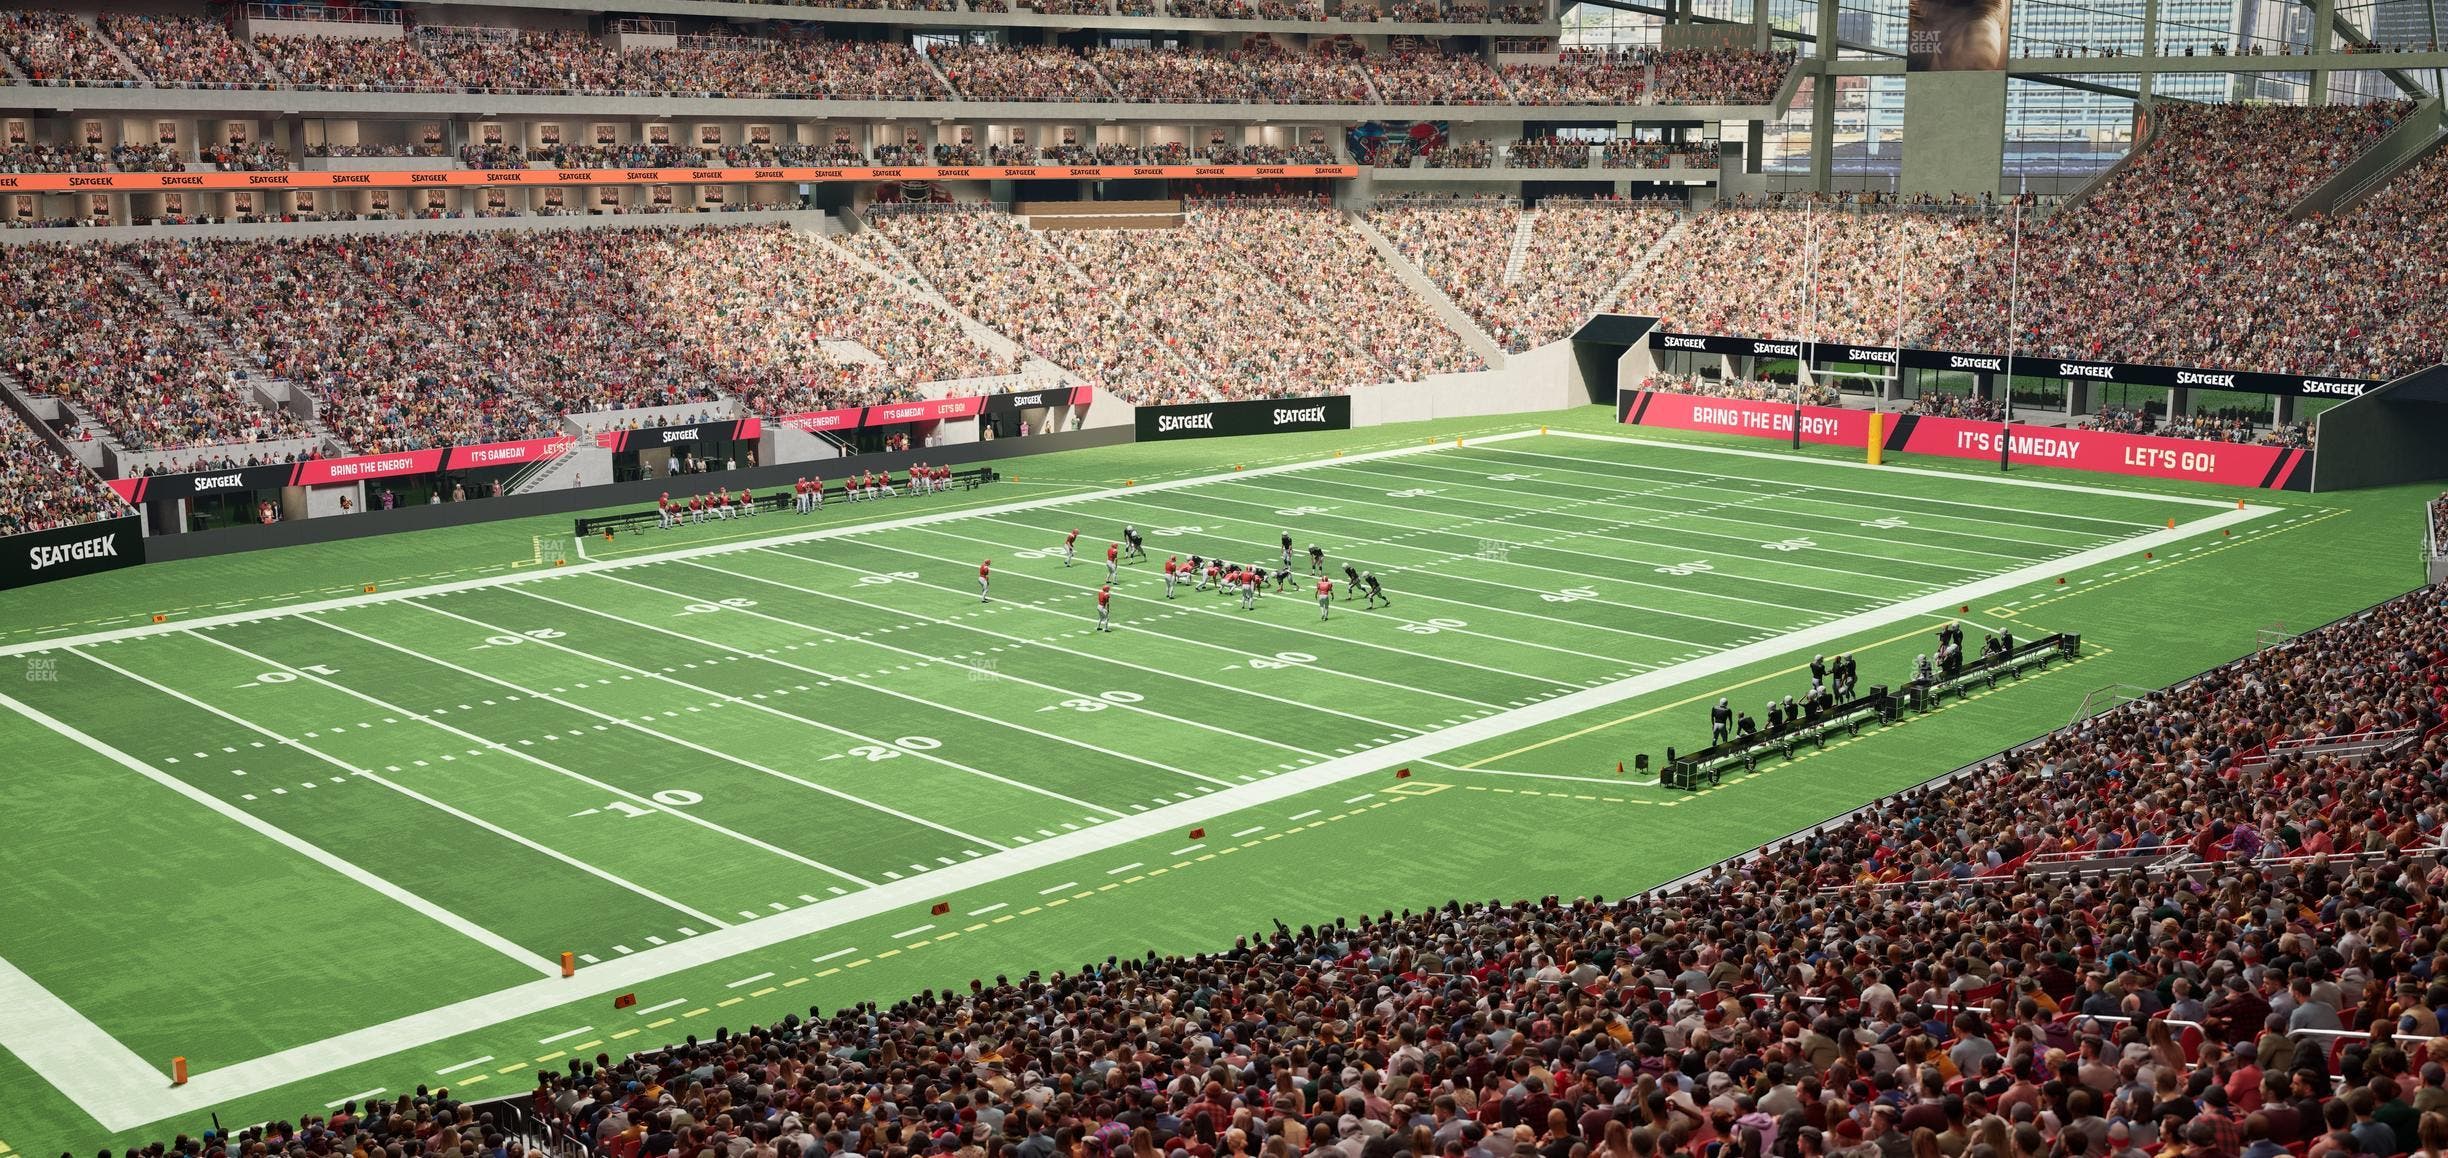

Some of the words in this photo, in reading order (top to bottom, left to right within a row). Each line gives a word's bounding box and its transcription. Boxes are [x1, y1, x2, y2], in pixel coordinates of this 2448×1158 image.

[69, 177, 113, 186] SEATGEEK
[161, 176, 204, 185] SEATGEEK
[249, 176, 289, 185] SEATGEEK
[335, 175, 371, 183] SEATGEEK
[412, 174, 447, 183] SEATGEEK
[487, 173, 521, 182] SEATGEEK
[559, 173, 591, 181] SEATGEEK
[754, 171, 783, 179] SEATGEEK
[1664, 336, 1706, 350] SEATGEEK
[1753, 342, 1798, 357] SEATGEEK
[1849, 349, 1896, 364] SEATGEEK
[1951, 355, 2001, 371] SEATGEEK
[2060, 363, 2114, 379] SEATGEEK
[2177, 371, 2235, 388] SEATGEEK
[2303, 379, 2366, 396] SEATGEEK
[1014, 394, 1042, 408] SEATGEEK
[896, 406, 924, 418] GAMEDAY
[938, 404, 954, 413] LET'S
[1159, 412, 1213, 432] SEATGEEK
[1274, 405, 1326, 425] SEATGEEK
[813, 416, 840, 427] ENERGY!
[1693, 406, 1738, 426] BRING
[1742, 411, 1770, 430] THE
[1773, 414, 1838, 436] ENRGY!
[663, 428, 699, 443] SEATGEEK
[1958, 431, 1990, 451] IT'S
[1994, 434, 2080, 459] GAMEDAY
[2125, 446, 2176, 470] LET'S
[2181, 449, 2215, 473] GO!
[331, 464, 358, 477] BRING
[359, 462, 376, 473] THE
[378, 458, 413, 472] ENERGY!
[471, 451, 487, 462] IT'S
[488, 447, 526, 460] GAMEDAY
[195, 473, 243, 491] SEATGEEK
[30, 533, 118, 570] SEATGEEK
[1654, 562, 1714, 576] 30
[1540, 588, 1599, 602] 40
[1397, 618, 1468, 635] 50
[1248, 651, 1318, 669] 40
[1060, 690, 1145, 712] 30
[847, 736, 942, 761] 20
[603, 789, 703, 818] 10
